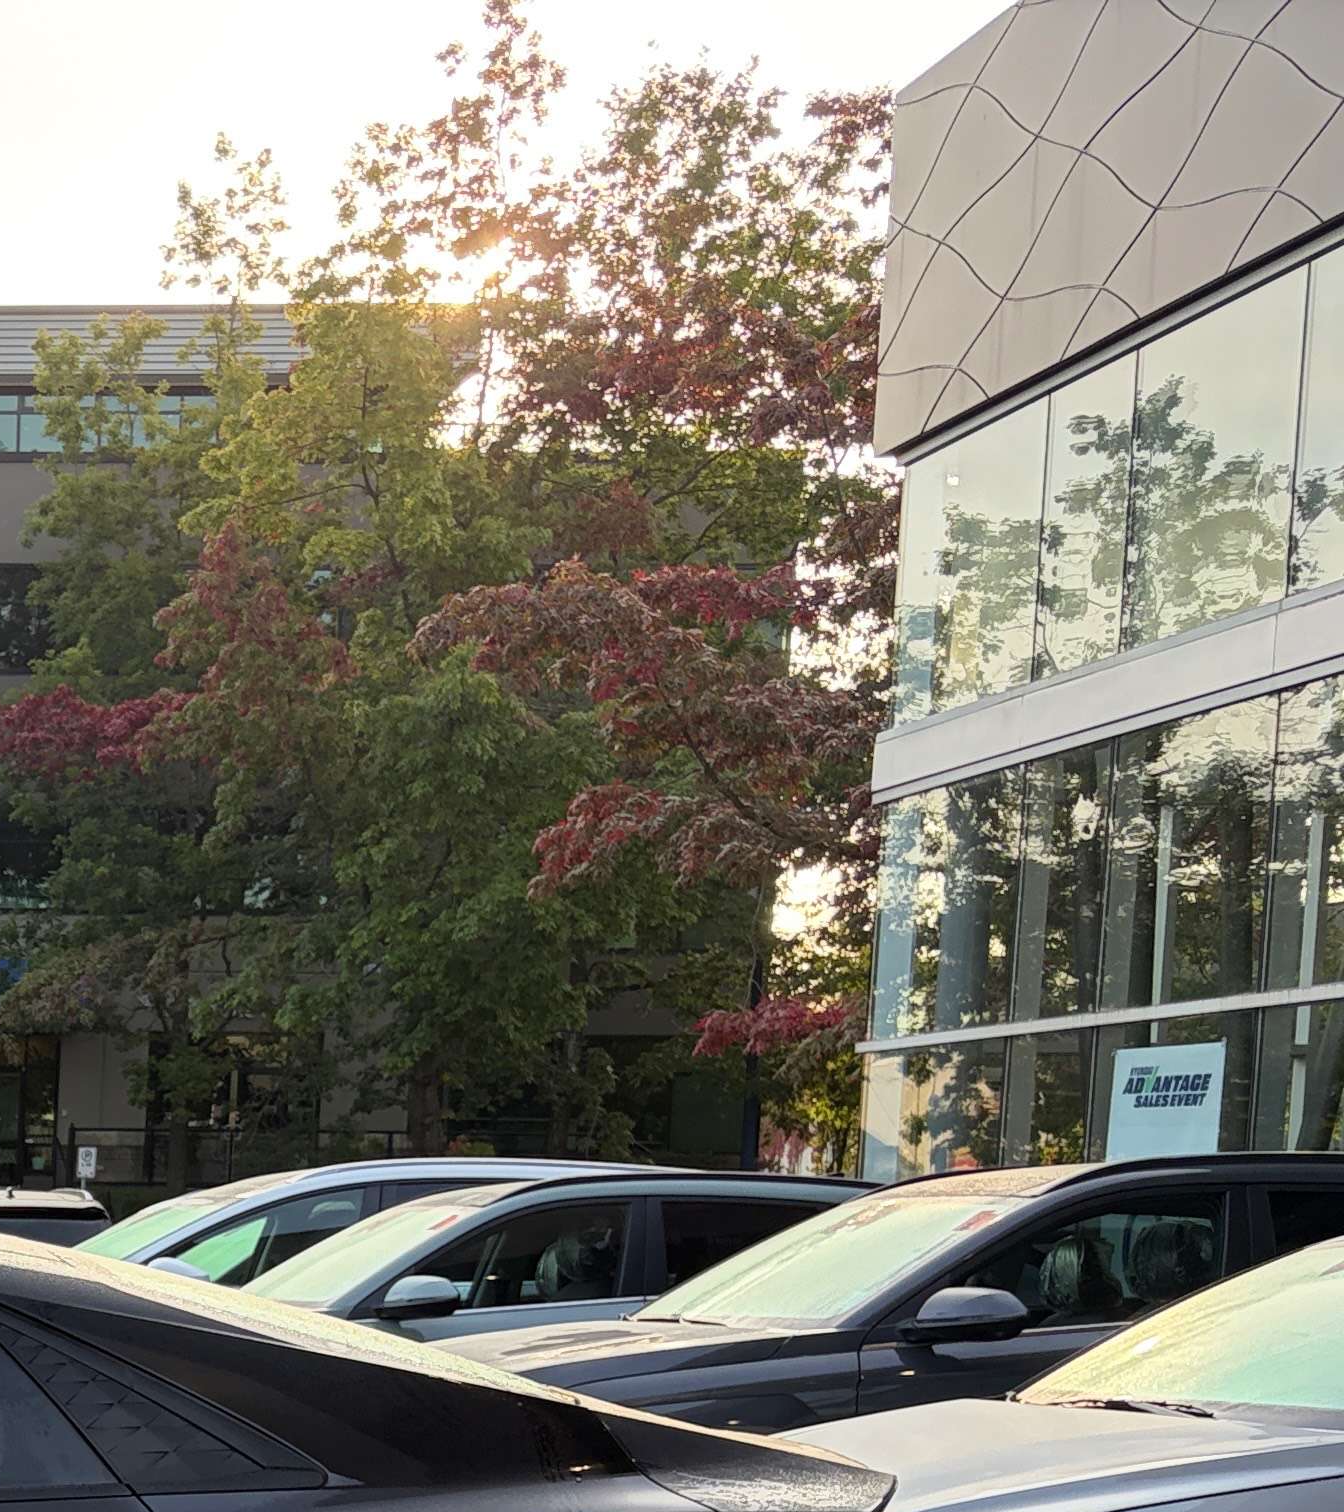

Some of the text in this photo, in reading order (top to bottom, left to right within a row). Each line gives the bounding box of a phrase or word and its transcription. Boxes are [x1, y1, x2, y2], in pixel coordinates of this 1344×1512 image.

[1122, 1071, 1212, 1095] ADVANTAGE
[1133, 1093, 1207, 1108] SALES EVENT
